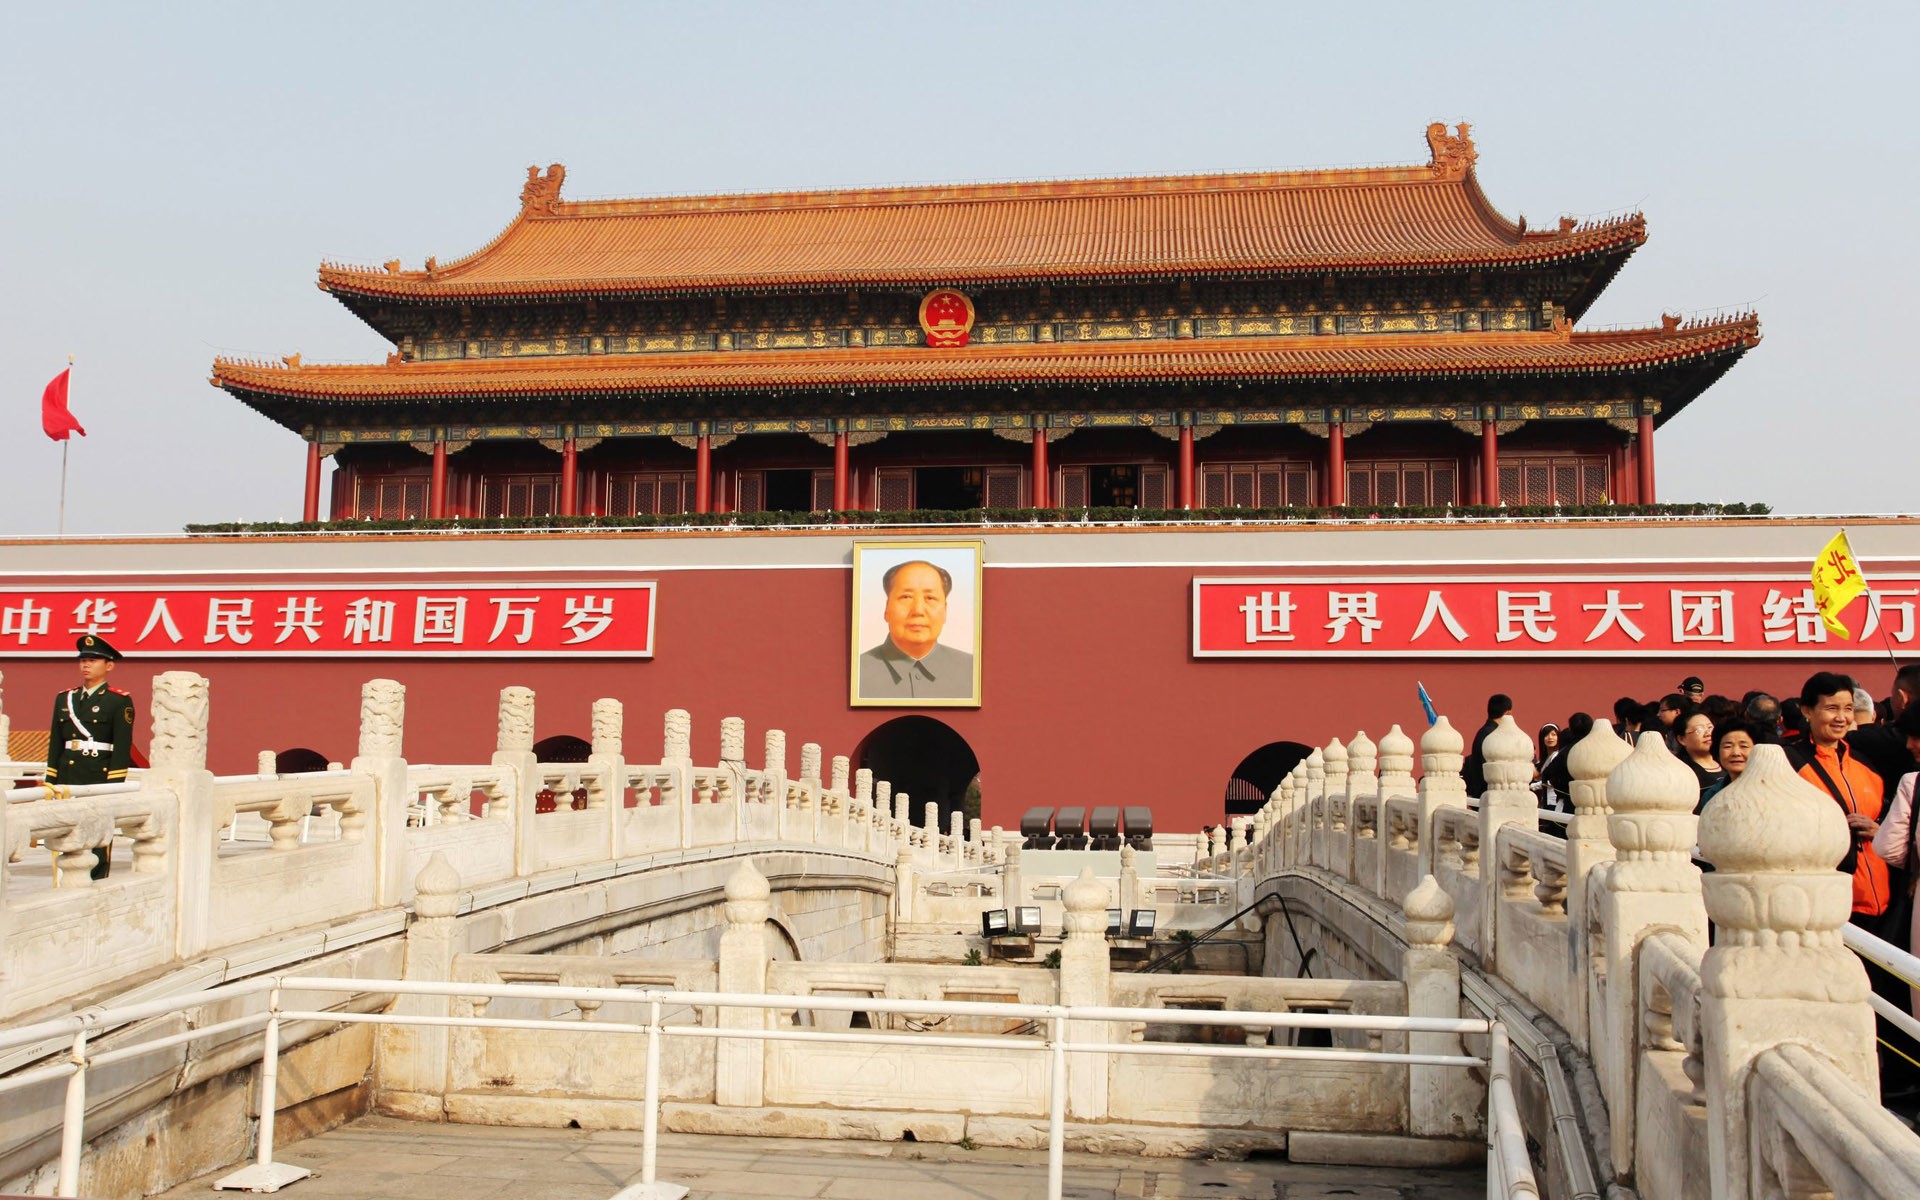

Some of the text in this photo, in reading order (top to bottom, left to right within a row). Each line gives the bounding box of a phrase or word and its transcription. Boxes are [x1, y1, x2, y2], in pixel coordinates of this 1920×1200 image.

[1, 595, 615, 645] 中华人民共和国万岁
[1239, 588, 1919, 643] 世界人民大团结万
